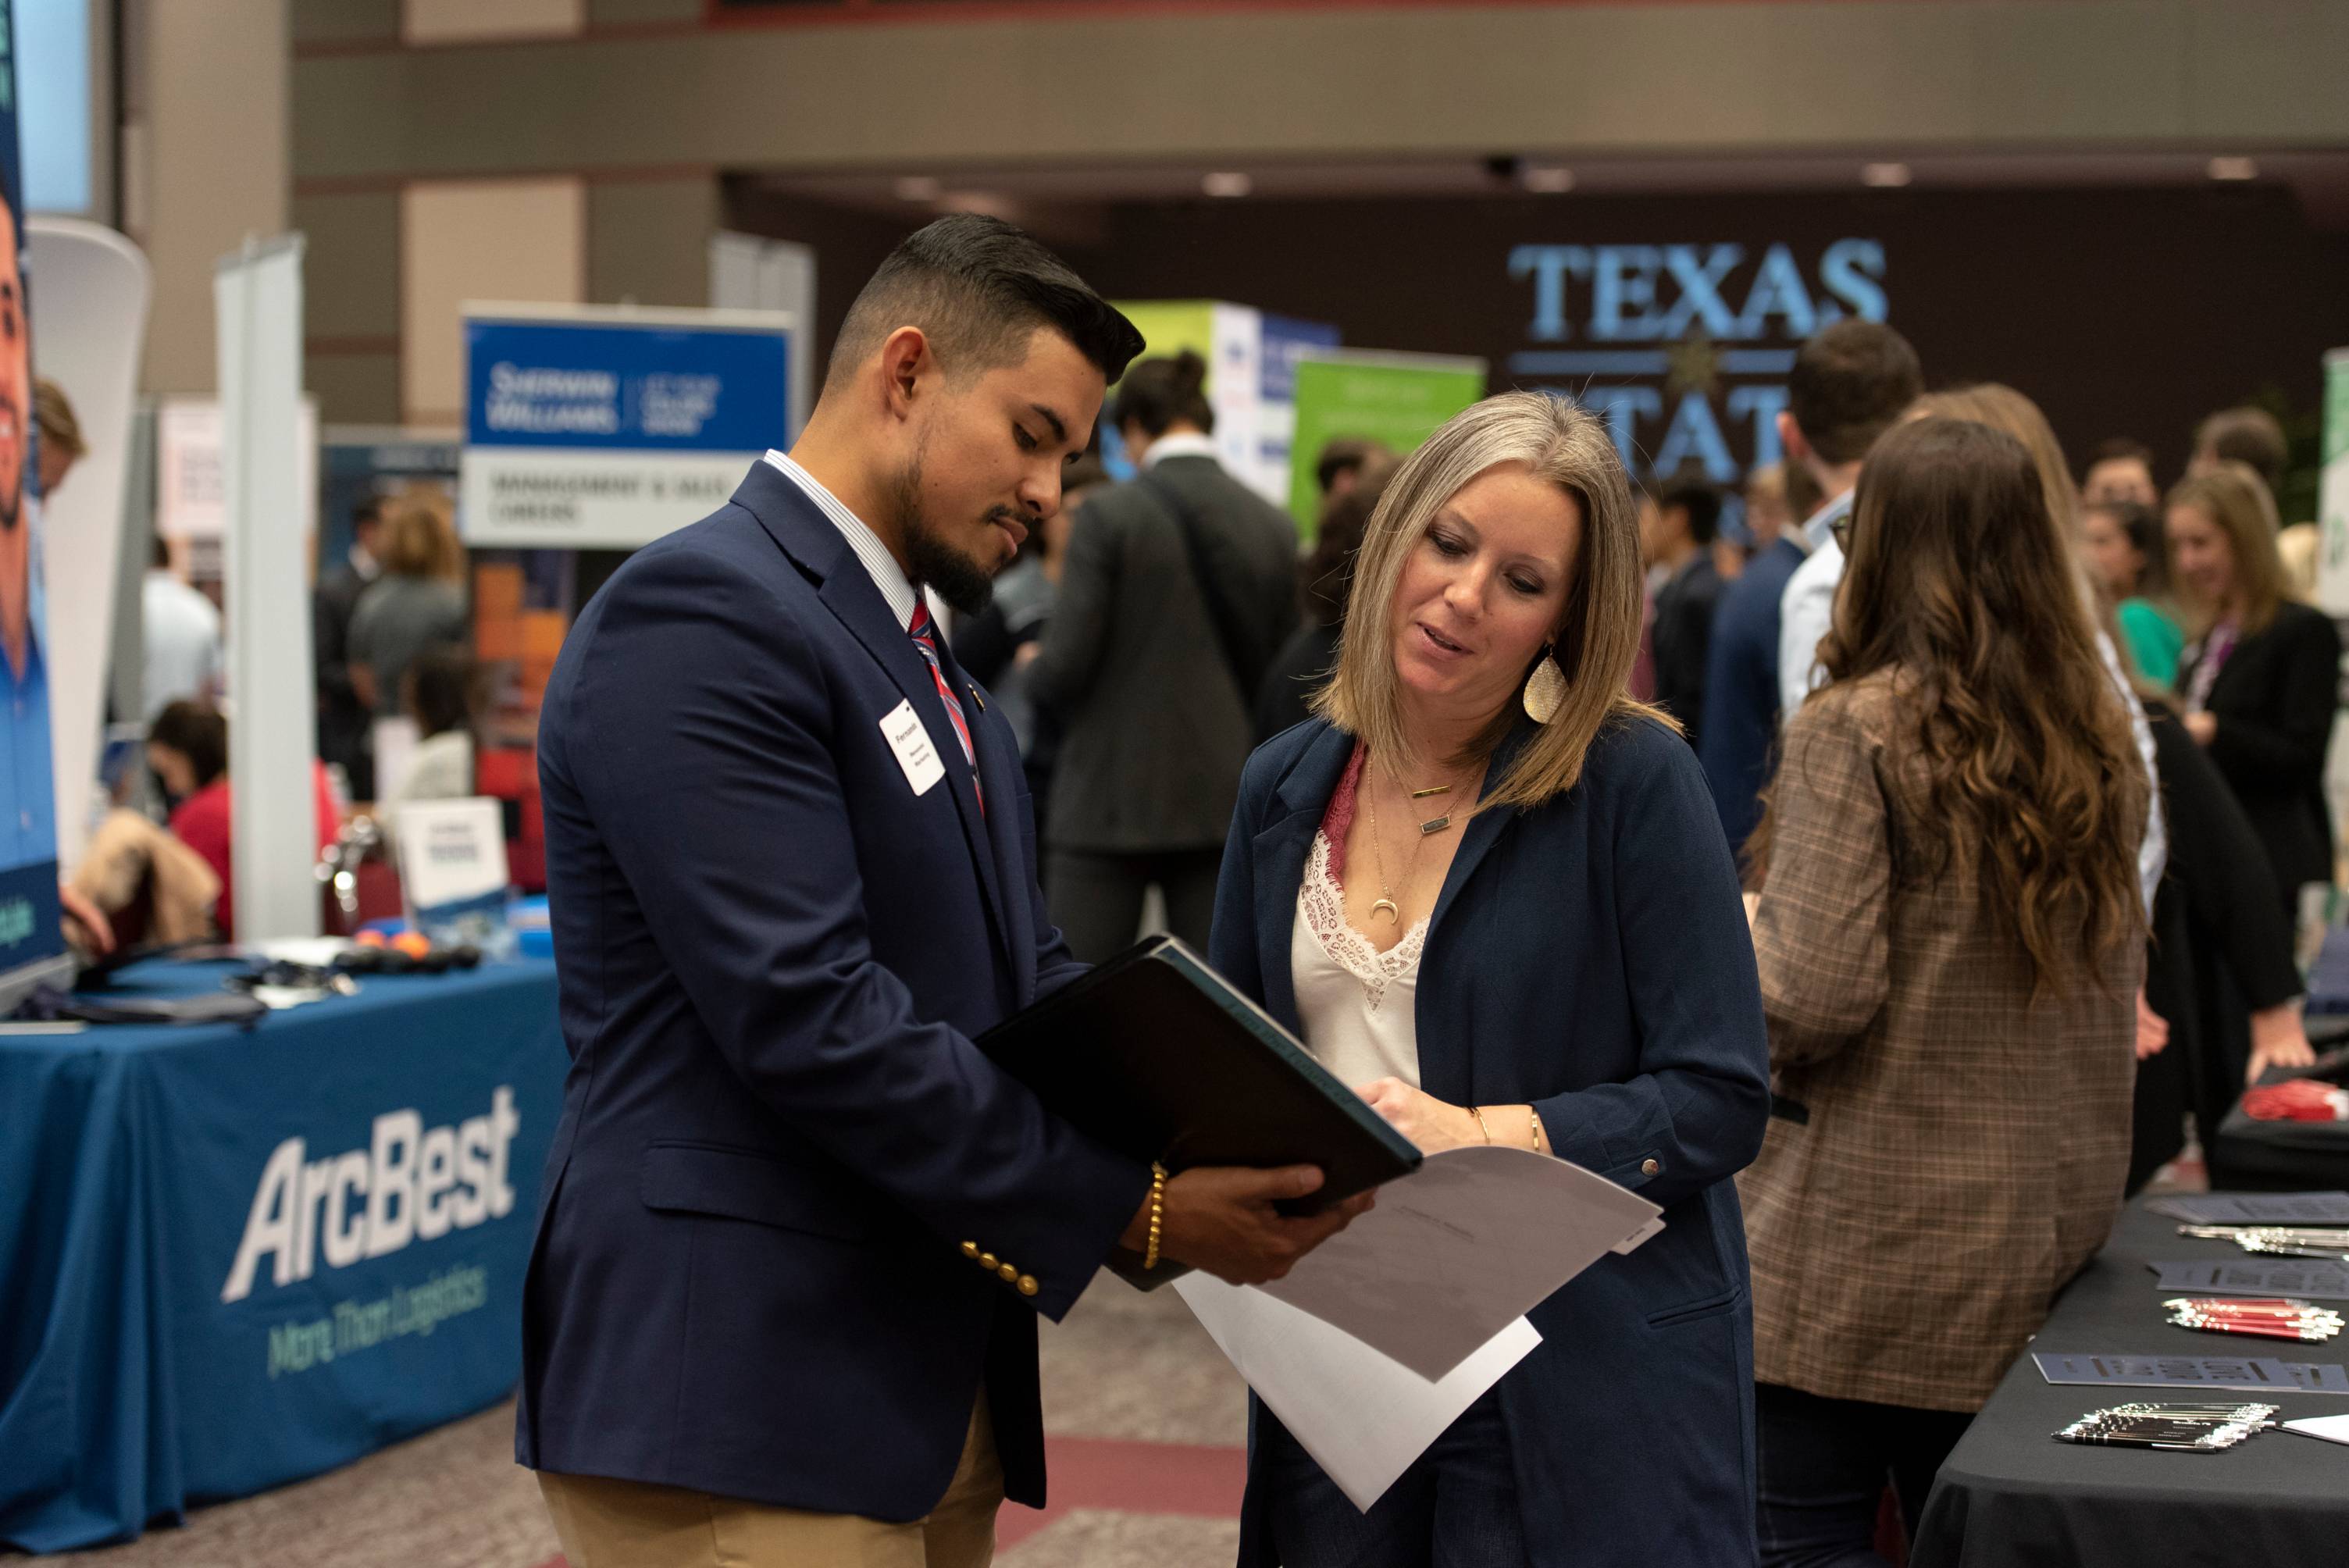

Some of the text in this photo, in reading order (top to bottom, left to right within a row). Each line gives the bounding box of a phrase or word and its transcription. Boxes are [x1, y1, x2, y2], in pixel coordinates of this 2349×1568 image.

[1507, 237, 1889, 340] TEXAS
[221, 1085, 520, 1303] ArcBest
[267, 1263, 488, 1381] More Than Logistics
